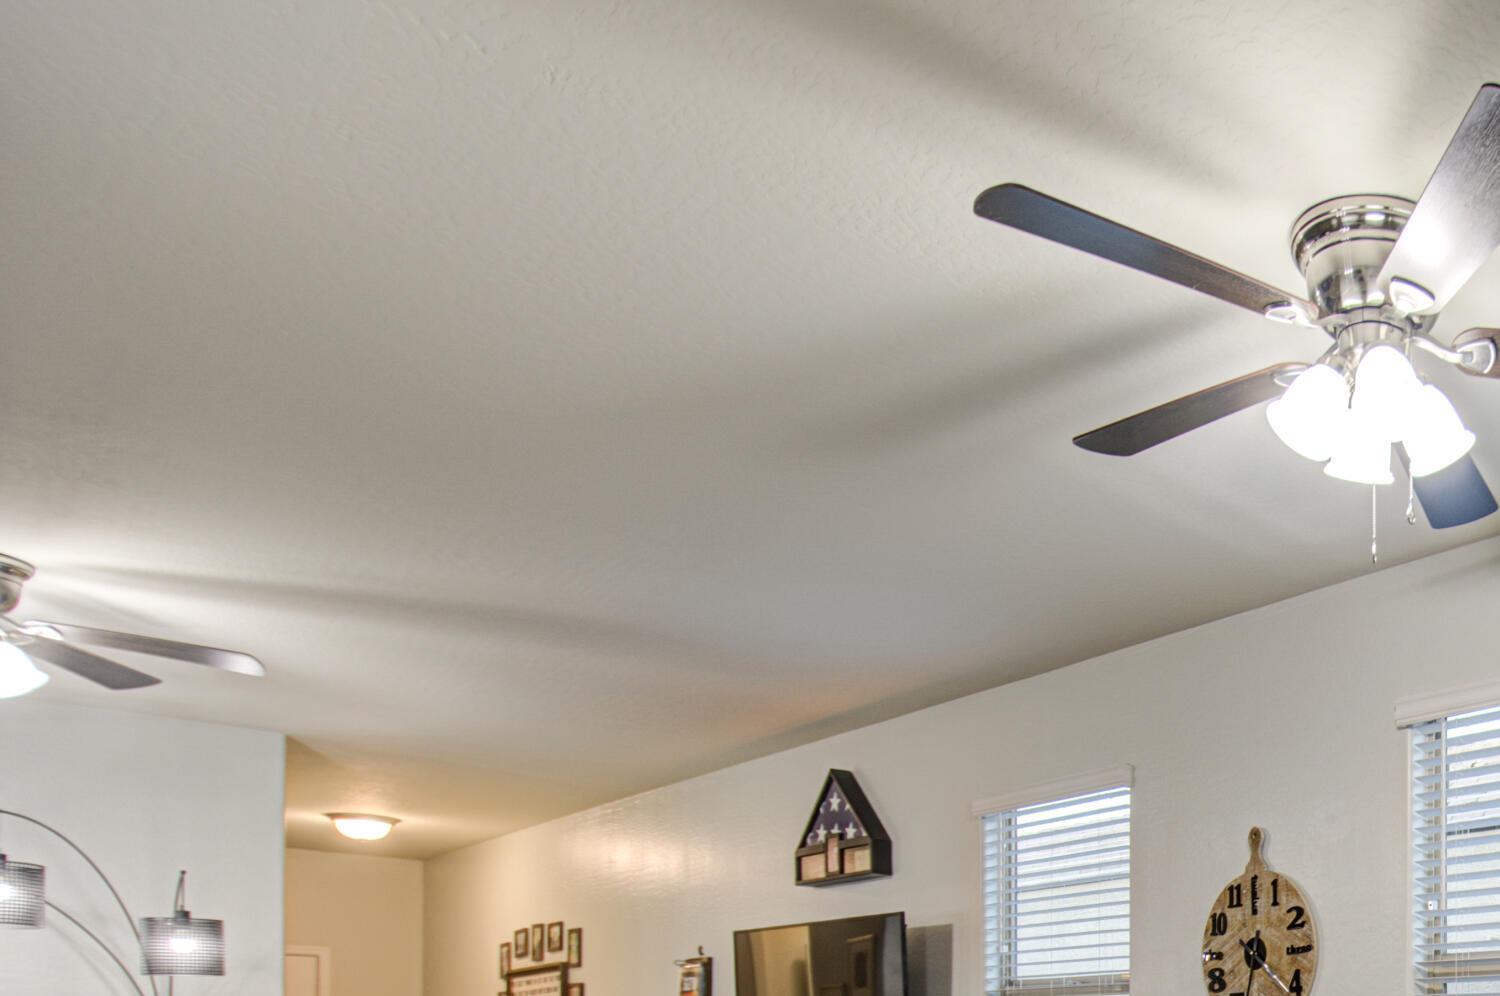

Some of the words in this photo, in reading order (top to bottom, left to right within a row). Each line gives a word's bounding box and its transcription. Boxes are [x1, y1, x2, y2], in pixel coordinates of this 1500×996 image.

[1227, 883, 1243, 908] 11
[1271, 878, 1280, 907] 1
[1210, 912, 1228, 937] 10
[1286, 906, 1306, 931] 2
[1286, 943, 1314, 956] three
[1207, 967, 1227, 993] 8
